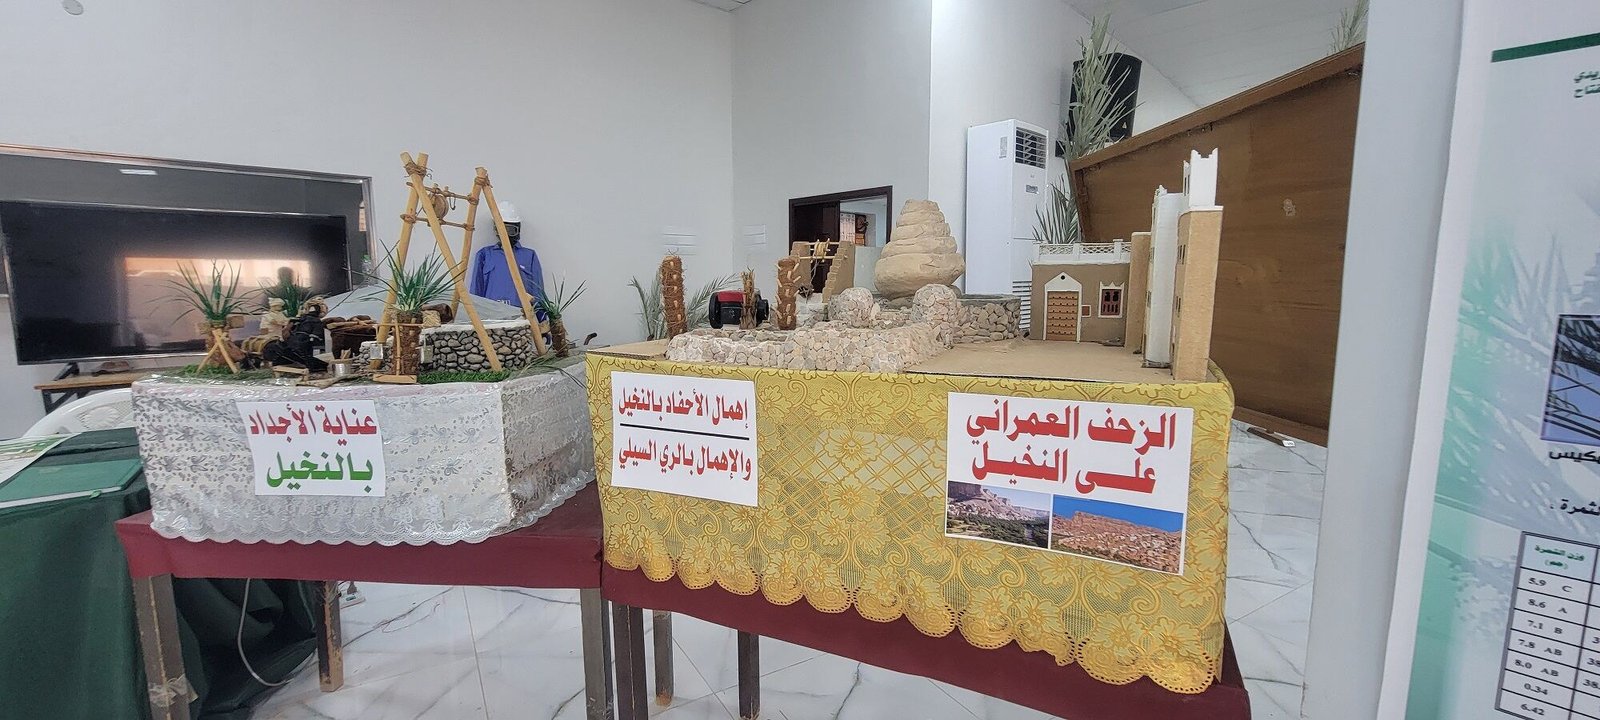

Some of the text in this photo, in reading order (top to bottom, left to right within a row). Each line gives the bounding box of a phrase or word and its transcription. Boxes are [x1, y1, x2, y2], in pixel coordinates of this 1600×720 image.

[619, 387, 748, 428] إهمال الأحفاد بالنخيل
[249, 403, 377, 446] عناية الأجداد
[966, 399, 1176, 455] الزحف العمراني
[619, 437, 751, 481] والإهمال بالري السيلي
[972, 441, 1156, 493] على النخيل
[267, 451, 374, 493] بالنخيل
[1528, 577, 1574, 593] 5.9 C
[1528, 598, 1568, 614] 8.6 A
[1527, 619, 1563, 635] 7.1 B
[1518, 638, 1563, 656] 7.8 AB
[1514, 659, 1559, 677] 8.0 AB
[1523, 683, 1548, 696] 0.34
[1520, 703, 1546, 716] 6.42
